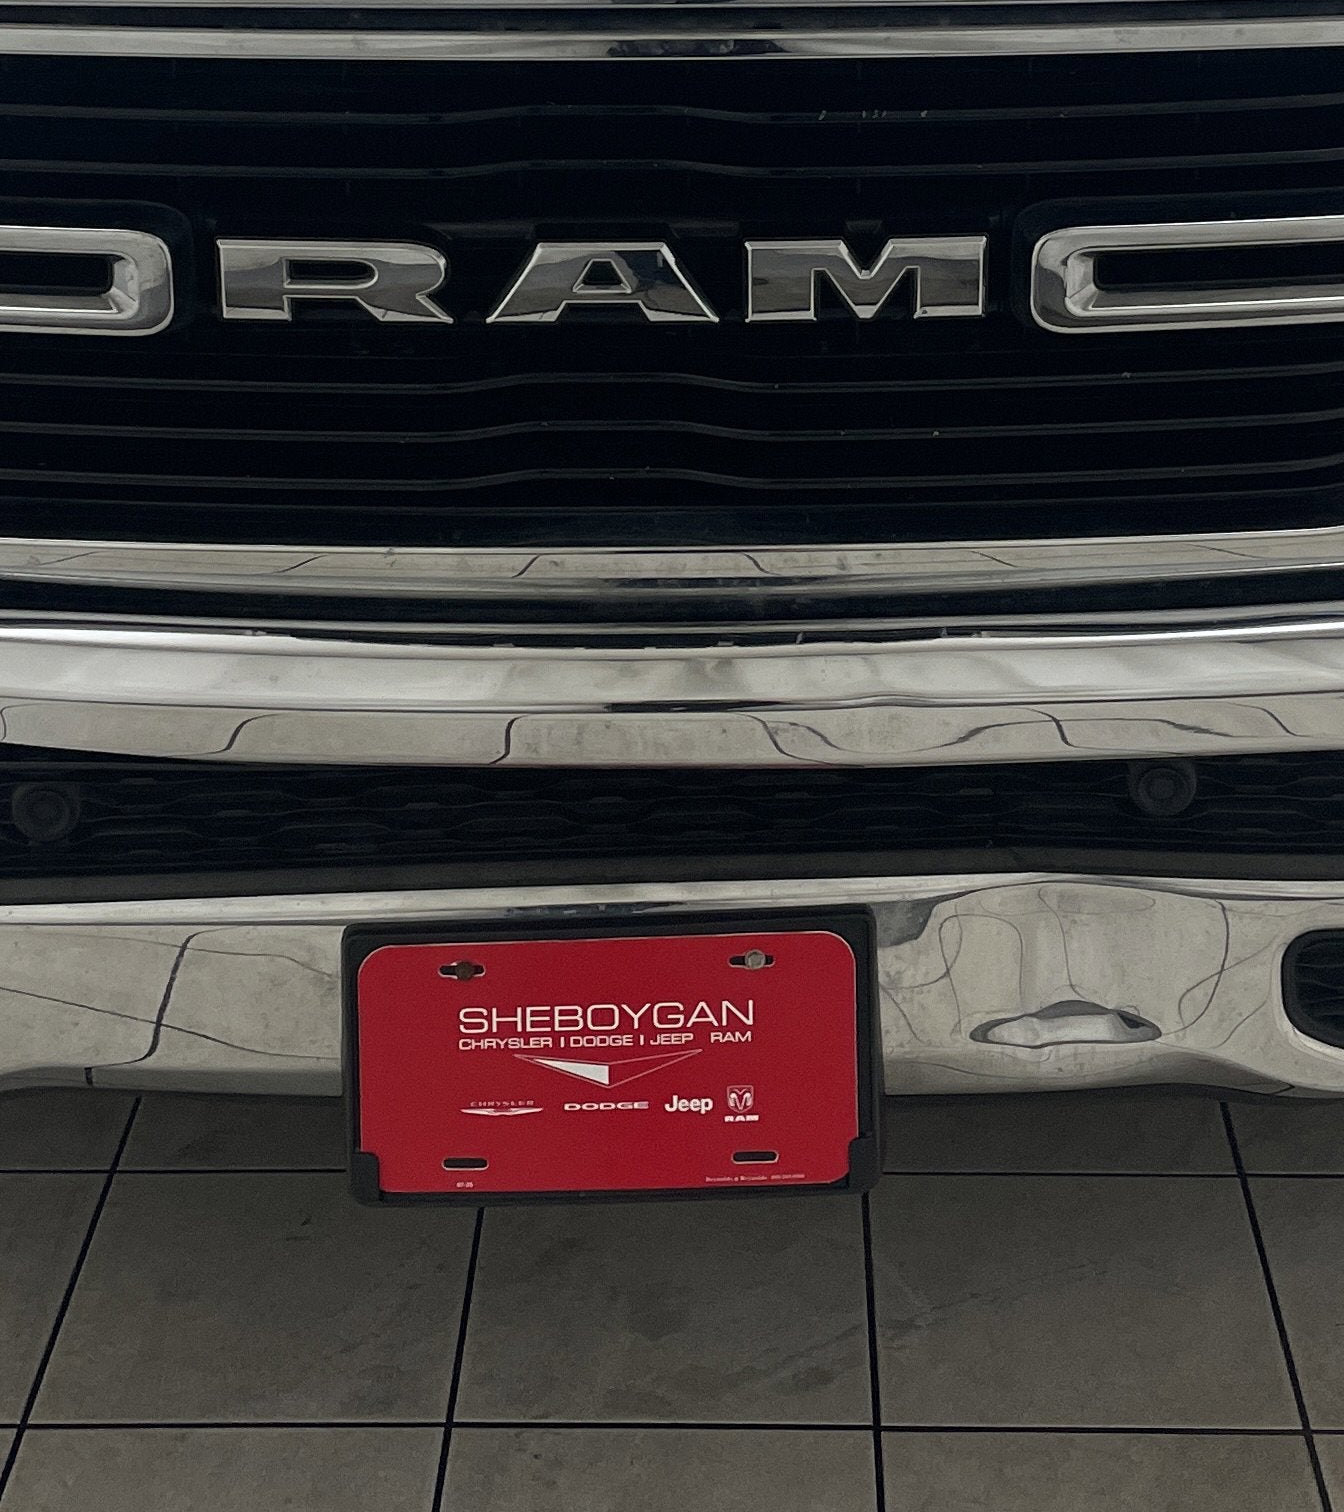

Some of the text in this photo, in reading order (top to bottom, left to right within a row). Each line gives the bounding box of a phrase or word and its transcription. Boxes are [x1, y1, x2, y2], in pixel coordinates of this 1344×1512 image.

[216, 235, 988, 322] RAM
[458, 999, 754, 1034] SHEBOYGAN
[458, 1031, 752, 1051] CHRYSLER DODGE JEEP RAM
[563, 1101, 650, 1111] DODGE
[664, 1095, 714, 1115] Jeep
[724, 1114, 760, 1123] RAM
